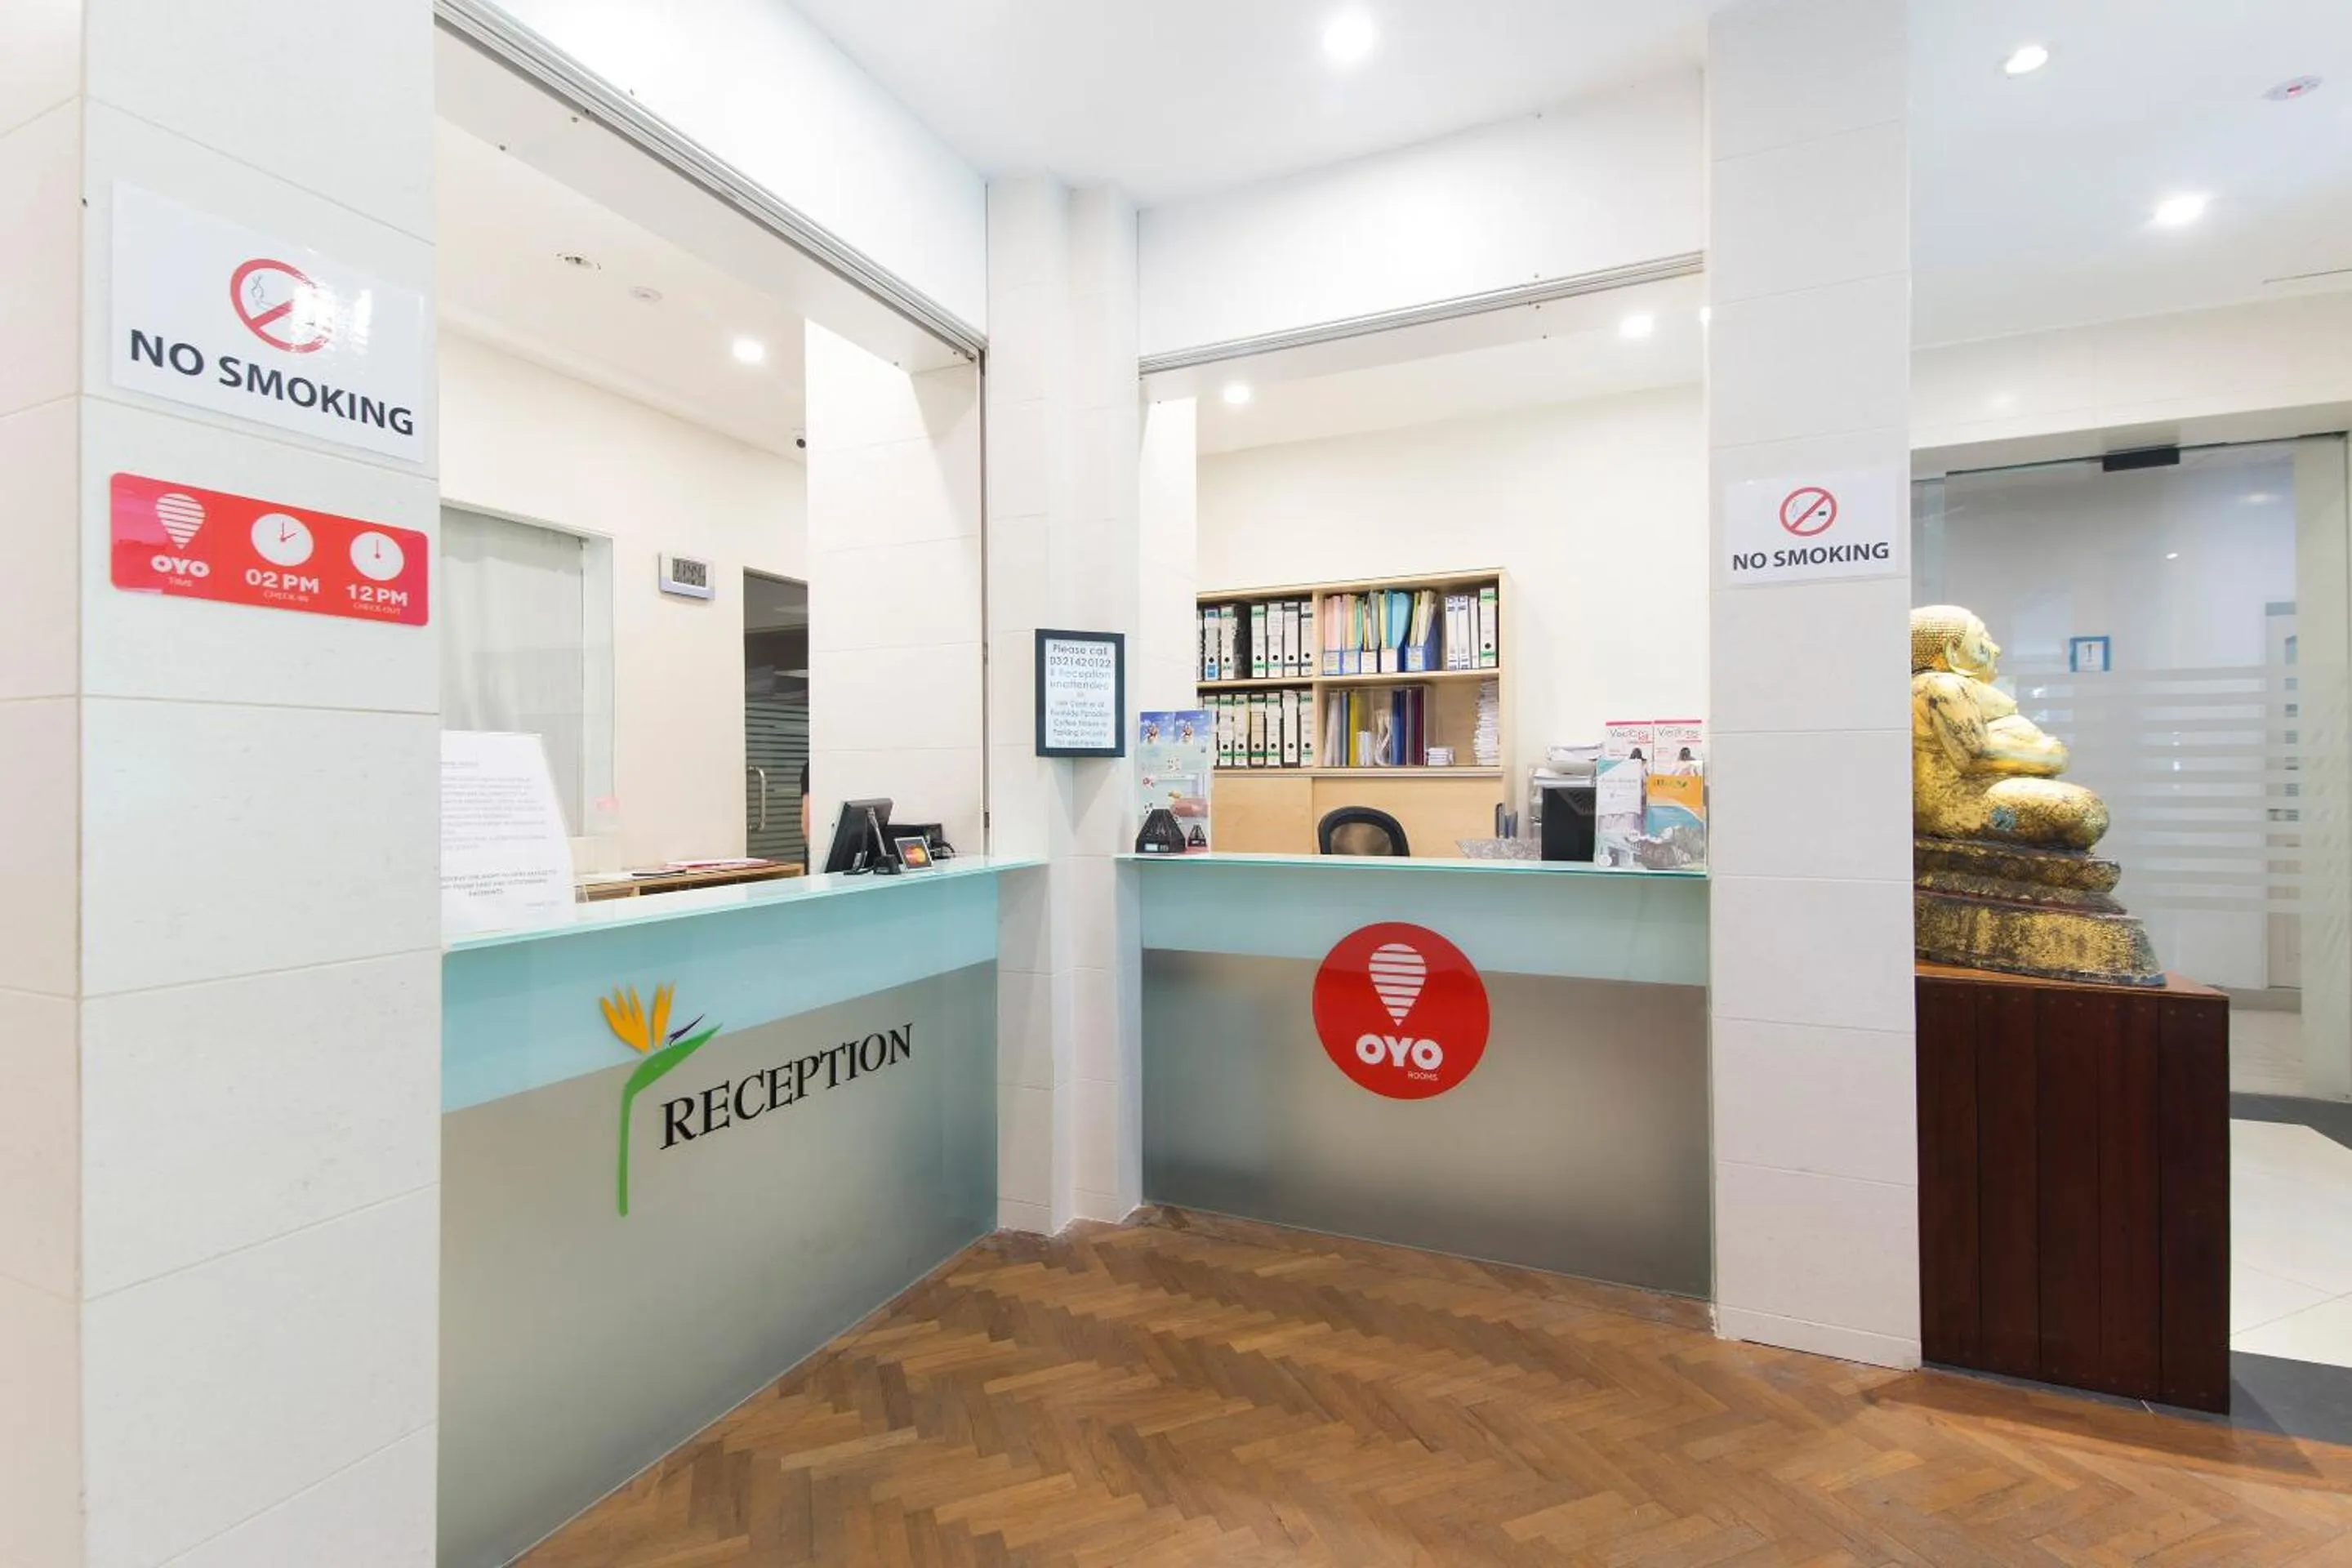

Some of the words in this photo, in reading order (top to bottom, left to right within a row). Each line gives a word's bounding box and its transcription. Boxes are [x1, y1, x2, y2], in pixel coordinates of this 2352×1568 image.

[130, 328, 205, 376] NO
[218, 355, 414, 436] SMOKING
[150, 554, 211, 578] OYO
[1732, 552, 1767, 571] NO
[1773, 541, 1890, 568] SMOKING
[245, 568, 278, 589] 02
[283, 573, 320, 595] PM
[346, 583, 374, 601] 12
[376, 588, 408, 608] PM
[1053, 644, 1086, 654] Please
[1355, 1033, 1444, 1071] OYO
[659, 1022, 913, 1151] RECEPTION
[1407, 1071, 1439, 1081] ROOMS
